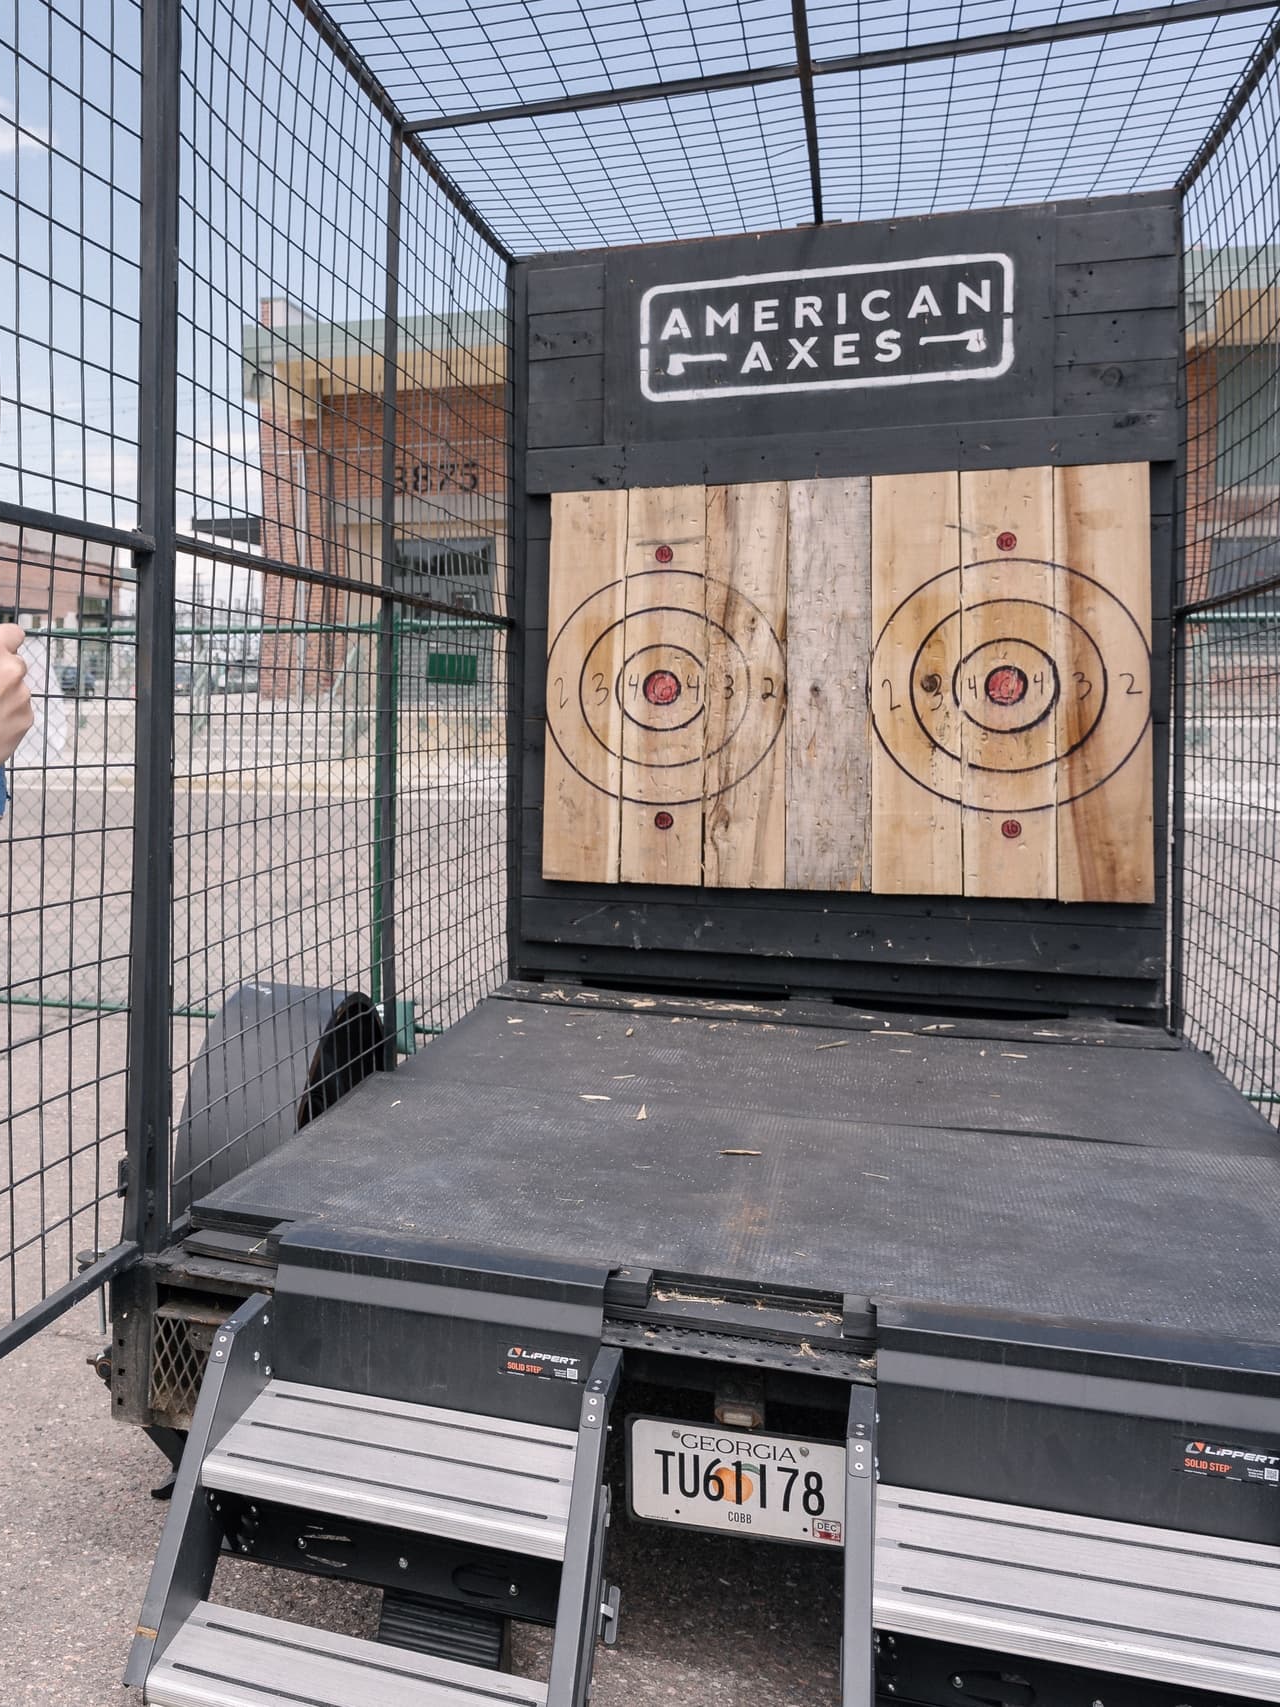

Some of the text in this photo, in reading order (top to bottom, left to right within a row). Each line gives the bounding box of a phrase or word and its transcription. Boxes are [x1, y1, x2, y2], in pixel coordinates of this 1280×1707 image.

[660, 279, 991, 341] AMERICAN
[740, 329, 902, 374] AXES
[554, 677, 569, 709] 2
[592, 672, 610, 706] 3
[628, 674, 640, 701] 4
[686, 674, 700, 704] 4
[724, 674, 735, 700] 3
[761, 677, 777, 700] 2
[881, 679, 901, 711] 2
[931, 673, 944, 711] 3
[968, 675, 978, 700] 4
[1033, 671, 1045, 695] 4
[1073, 671, 1093, 701] 3
[1120, 672, 1143, 695] 2
[507, 1361, 525, 1372] SOLID
[680, 1433, 798, 1464] GEORGIA
[1184, 1458, 1208, 1470] SOLID
[654, 1448, 825, 1517] TU61178
[728, 1511, 752, 1525] COBB
[817, 1522, 837, 1532] DEC
